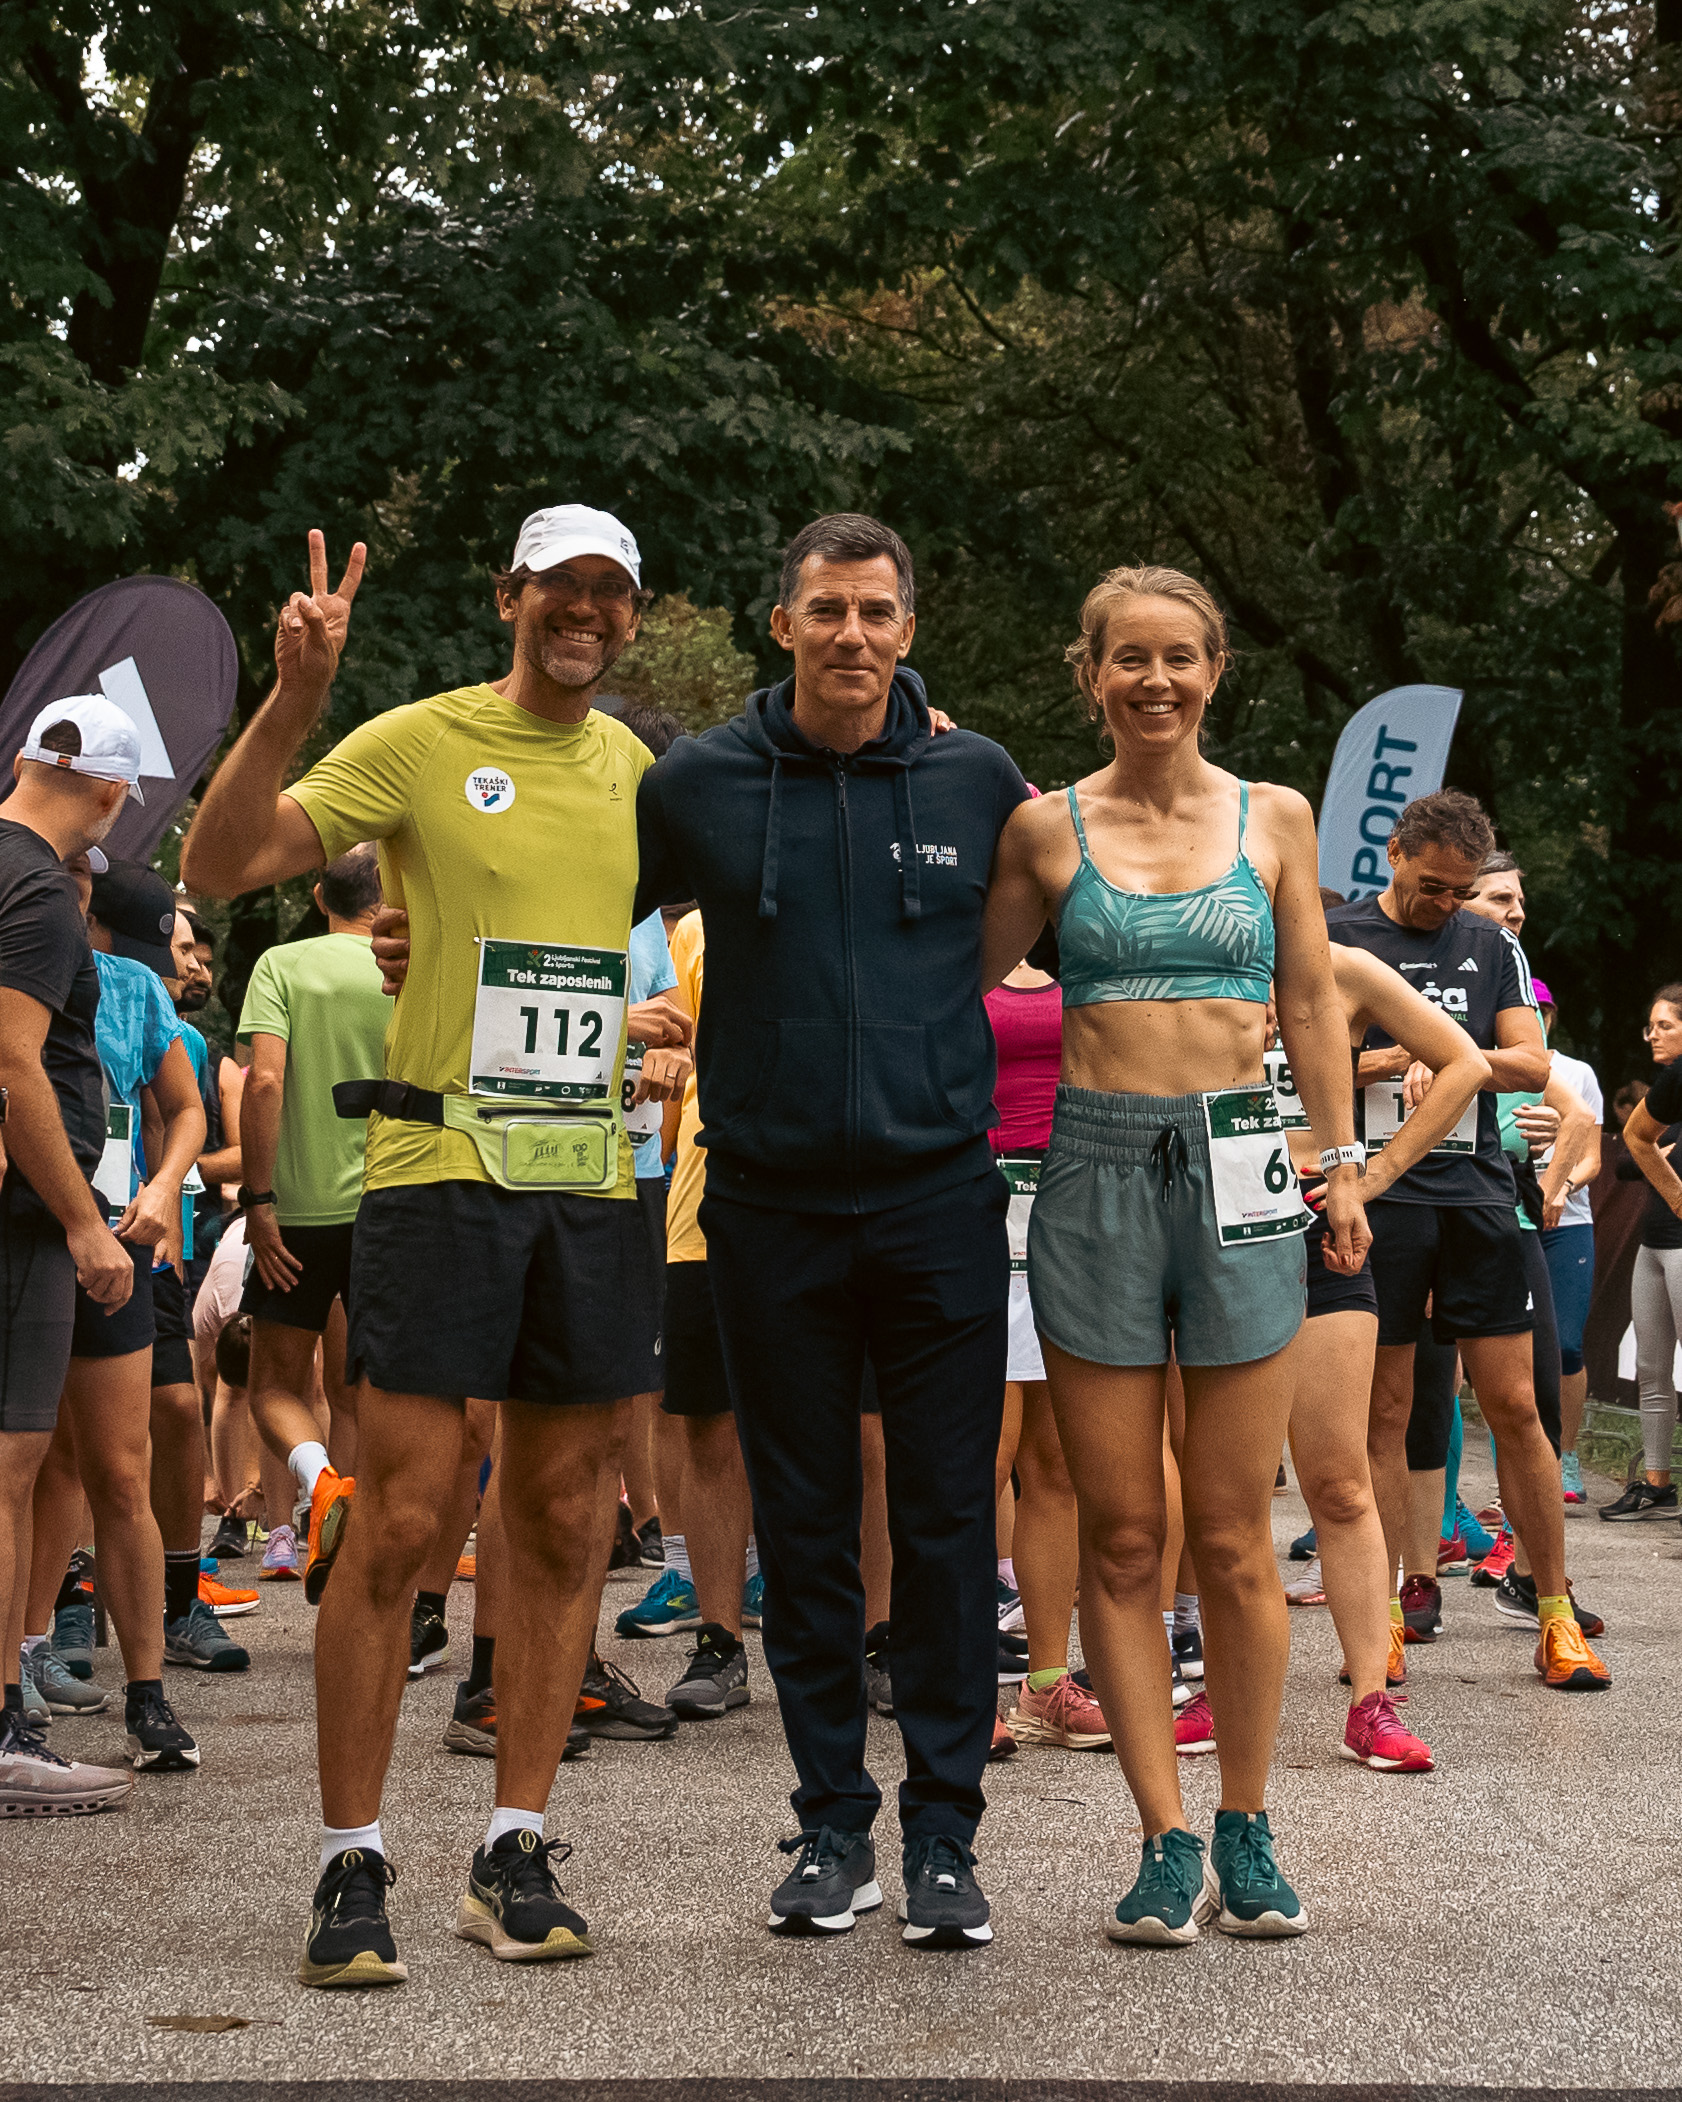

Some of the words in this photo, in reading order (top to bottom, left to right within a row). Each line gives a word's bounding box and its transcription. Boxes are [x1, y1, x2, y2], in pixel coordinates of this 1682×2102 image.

[473, 777, 508, 785] TEKAŠKI
[474, 784, 507, 792] TRENER
[915, 843, 957, 856] LJUBLJANA
[925, 854, 935, 864] JE
[507, 968, 537, 984] Tek
[539, 974, 612, 990] zaposlenih
[520, 1006, 603, 1058] 112
[504, 1066, 541, 1075] INTERSPORT
[1231, 1116, 1260, 1131] Tek
[1264, 1148, 1299, 1194] 6
[1015, 1181, 1038, 1192] Tek
[1247, 1208, 1278, 1218] INTERSPORT
